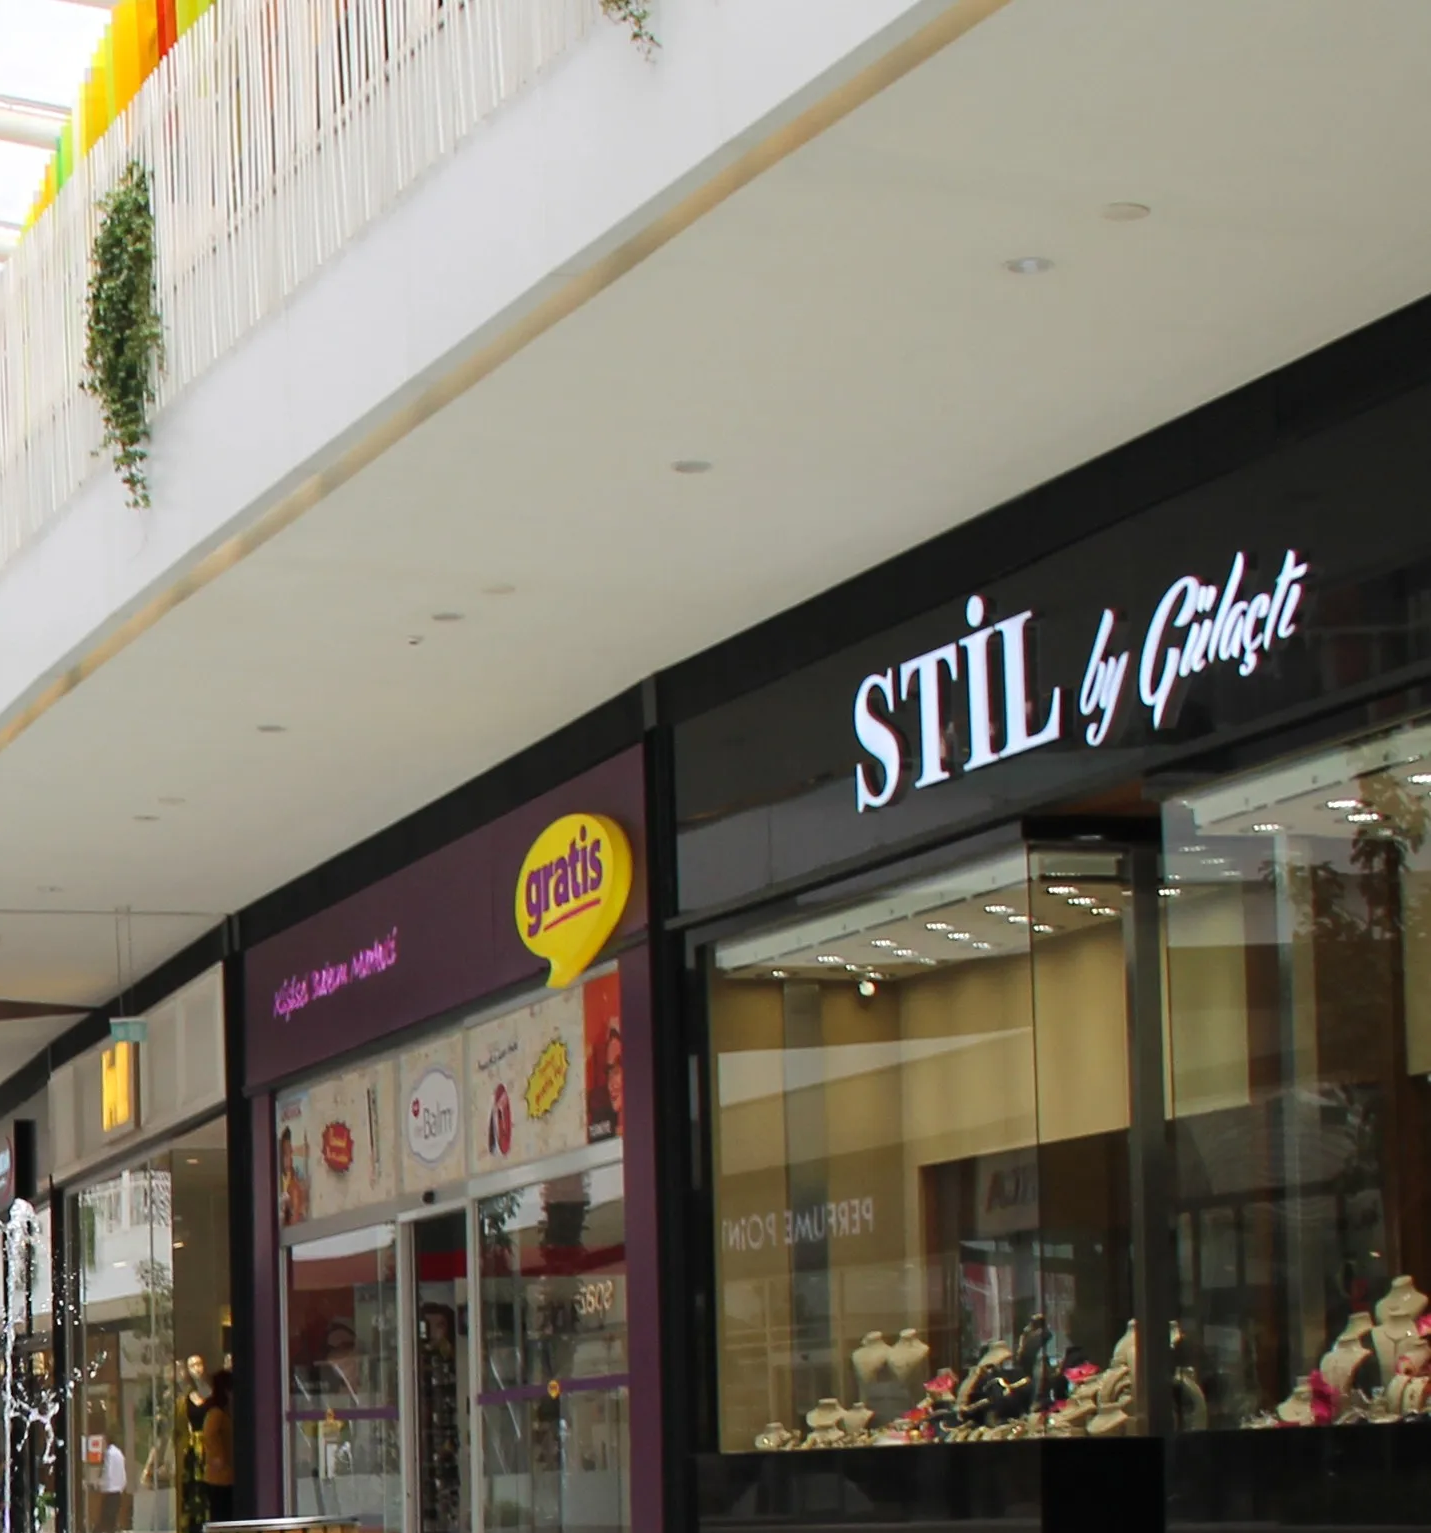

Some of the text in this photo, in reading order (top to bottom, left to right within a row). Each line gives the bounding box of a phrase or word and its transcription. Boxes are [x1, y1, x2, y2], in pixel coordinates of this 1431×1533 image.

[853, 594, 1061, 813] STİL
[1079, 607, 1129, 747] by
[525, 823, 604, 939] gratis
